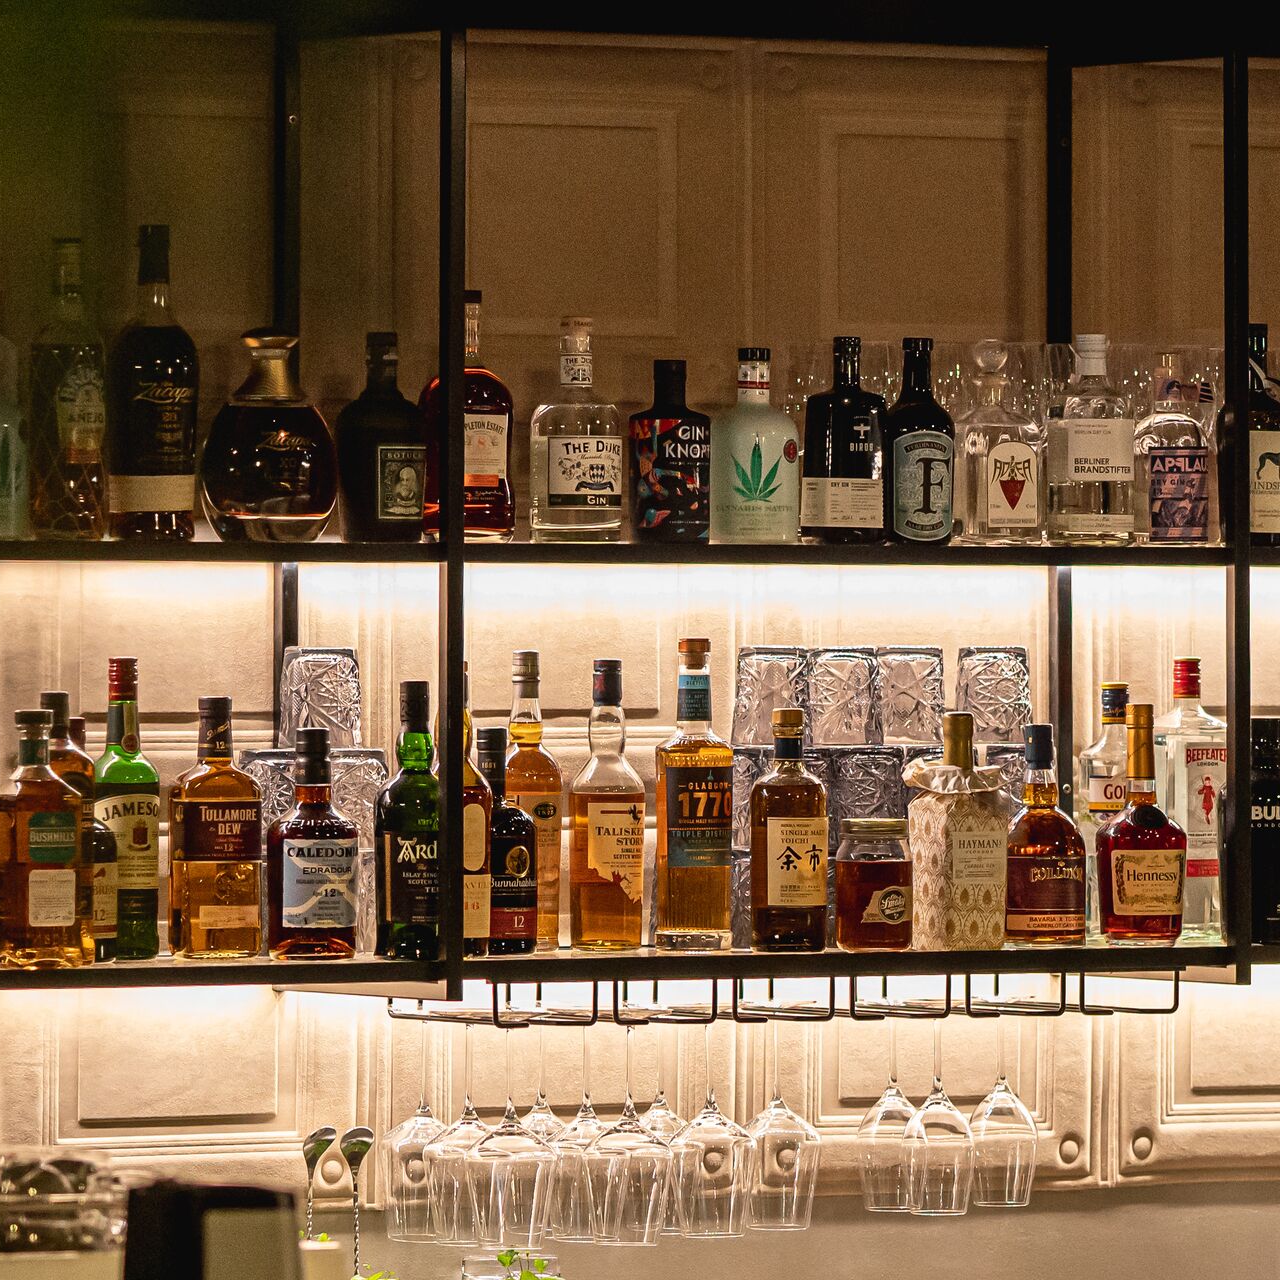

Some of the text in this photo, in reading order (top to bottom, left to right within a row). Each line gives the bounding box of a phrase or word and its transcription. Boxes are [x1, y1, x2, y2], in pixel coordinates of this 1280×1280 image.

[678, 425, 705, 441] GIN
[562, 443, 590, 457] THE
[1074, 466, 1131, 474] BRANDSTIFTER
[913, 457, 951, 515] F
[587, 496, 607, 506] GIN
[102, 801, 159, 822] JAMESO
[678, 791, 733, 818] 1770
[199, 805, 258, 822] TULLAMORE
[217, 822, 242, 836] DEW
[30, 831, 76, 843] BUSHMILLS
[776, 844, 823, 873] 余市
[302, 866, 353, 875] EDRADOUR
[1126, 869, 1178, 884] Hennessy
[323, 888, 336, 898] 12
[513, 915, 526, 929] 12
